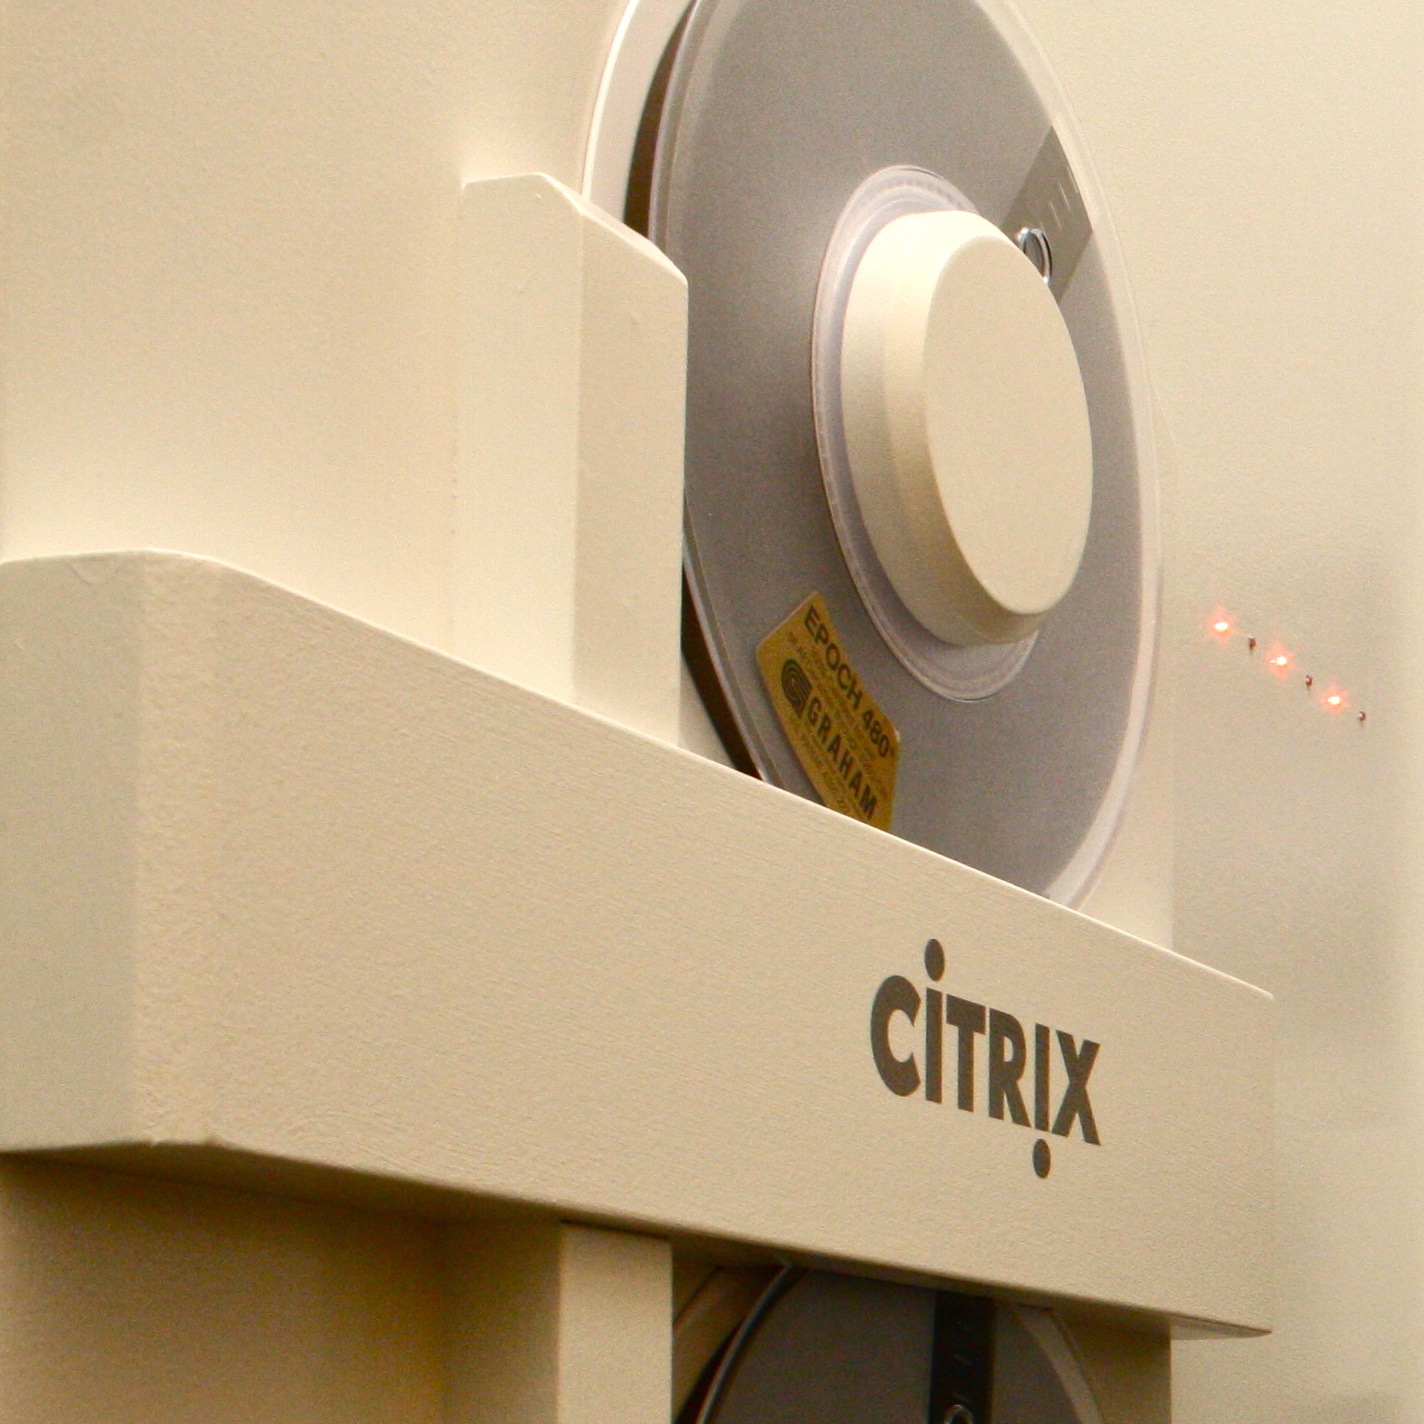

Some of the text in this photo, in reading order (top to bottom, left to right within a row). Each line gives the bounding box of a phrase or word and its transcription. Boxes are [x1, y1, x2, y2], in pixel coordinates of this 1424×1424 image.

[803, 605, 864, 711] EPOCH
[861, 710, 891, 759] 480
[806, 697, 879, 821] GRAHAM
